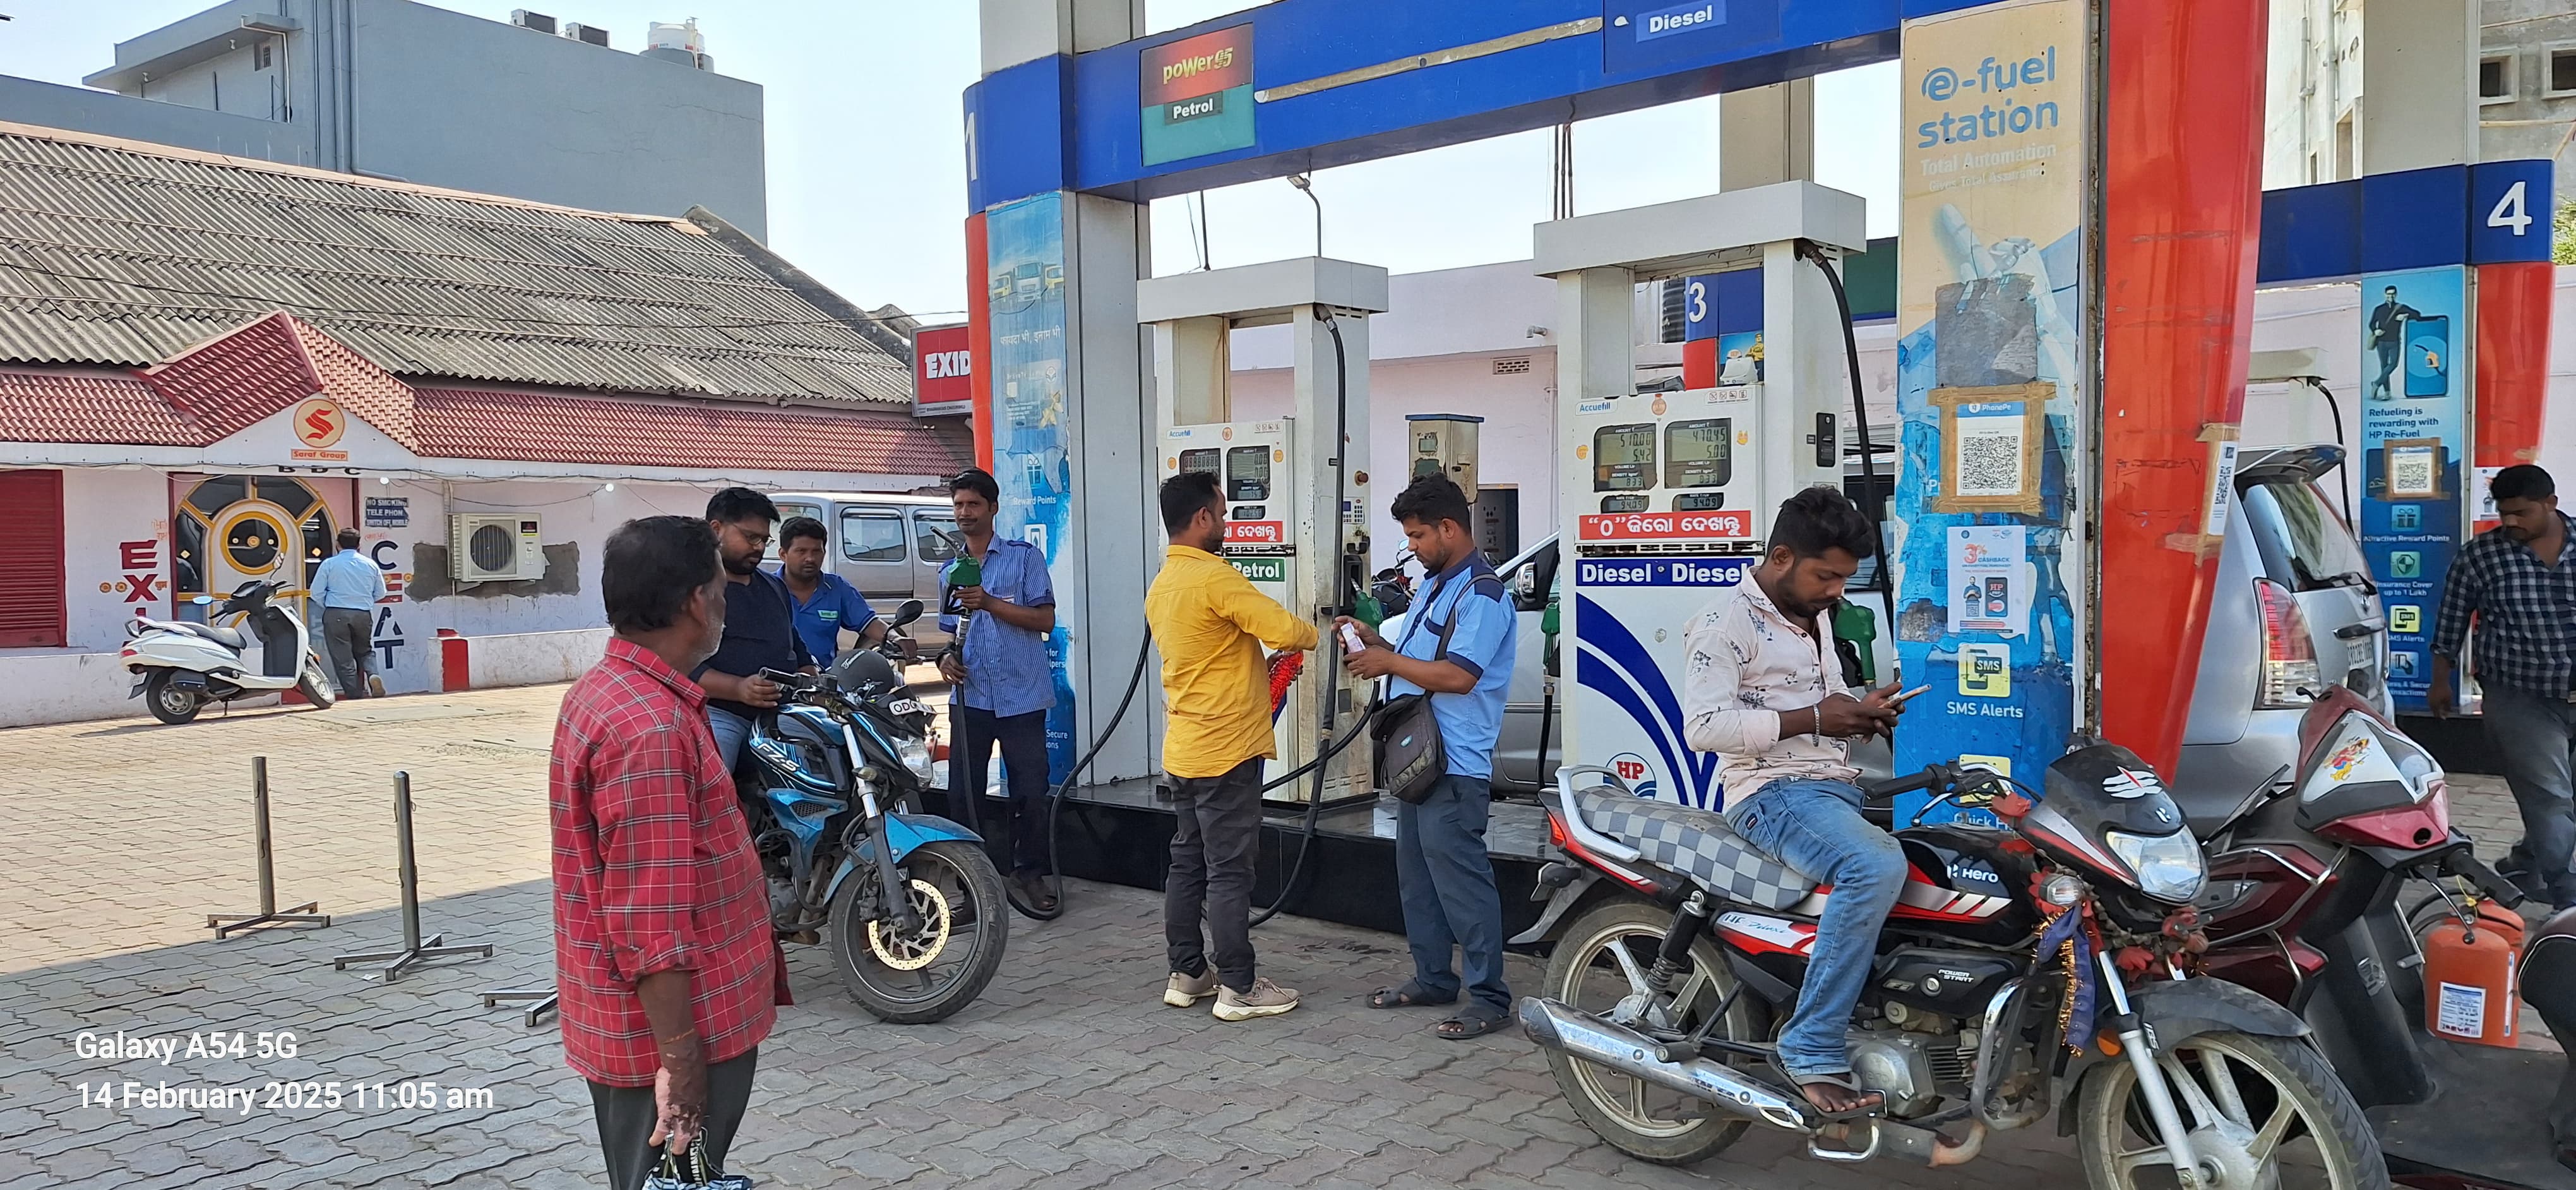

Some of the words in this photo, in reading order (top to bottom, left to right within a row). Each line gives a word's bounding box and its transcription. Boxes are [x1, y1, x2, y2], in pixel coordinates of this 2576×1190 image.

[1649, 5, 1713, 33] Diesel
[1173, 97, 1213, 119] Petrol
[1917, 99, 2059, 149] station
[965, 112, 977, 182] 1
[1921, 155, 1957, 176] Total
[1964, 143, 2056, 169] Automation
[1960, 174, 1986, 187] Total
[2488, 181, 2533, 236] 4
[1689, 282, 1707, 323] 3
[1052, 324, 1061, 339] भी
[925, 350, 970, 379] EXID
[2369, 407, 2413, 417] Refueling
[2414, 407, 2423, 415] is
[2369, 419, 2416, 428] rewarding
[2419, 418, 2438, 426] with
[2369, 430, 2382, 439] HP
[2384, 430, 2420, 438] Re-Fuel
[320, 451, 346, 459] Group
[1013, 495, 1036, 506] Reward
[1037, 495, 1056, 504] Points
[1232, 561, 1280, 578] Petrol
[1582, 563, 1652, 583] Diesel
[1671, 563, 1748, 583] Diesel
[1989, 583, 2004, 591] HP
[371, 540, 405, 670] CEAT
[1049, 647, 1058, 657] for
[1049, 659, 1065, 670] lpers
[1976, 659, 2001, 671] SMS
[1947, 701, 1977, 716] SMS
[1980, 703, 2024, 718] Alerts
[1046, 728, 1068, 740] Secure
[1616, 761, 1645, 780] HP
[1938, 968, 1971, 977] POWER
[1943, 974, 1975, 983] START
[1861, 1070, 1890, 1084] ero
